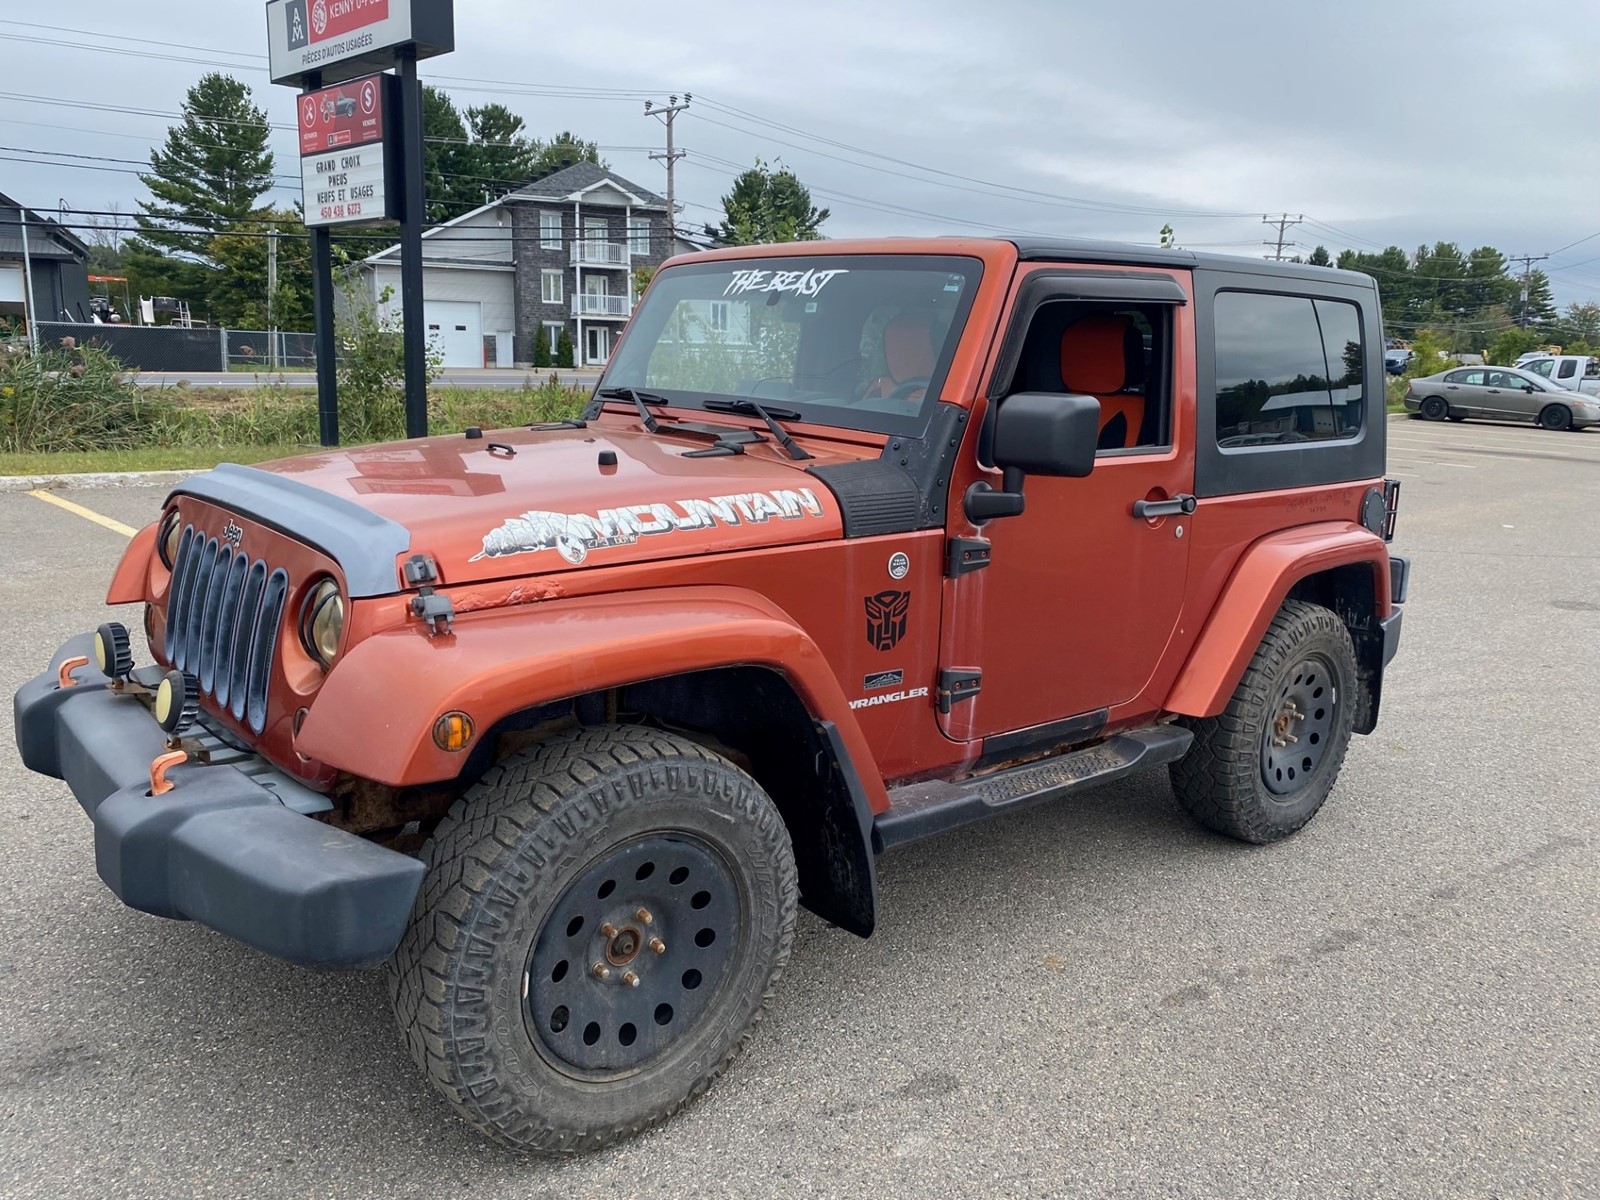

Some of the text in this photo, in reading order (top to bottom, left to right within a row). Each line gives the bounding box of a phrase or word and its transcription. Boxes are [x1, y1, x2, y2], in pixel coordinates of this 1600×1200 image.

[330, 0, 354, 19] KENNY
[301, 50, 322, 65] PIÈCES
[345, 32, 373, 52] USAGÉES
[316, 154, 361, 174] GRAND CHOIX
[328, 173, 348, 187] PNEUS
[317, 184, 374, 205] NEUFS ET USAGES
[722, 268, 850, 298] THE BEAST
[564, 486, 825, 539] MOUNTAIN
[222, 518, 243, 548] Jeep
